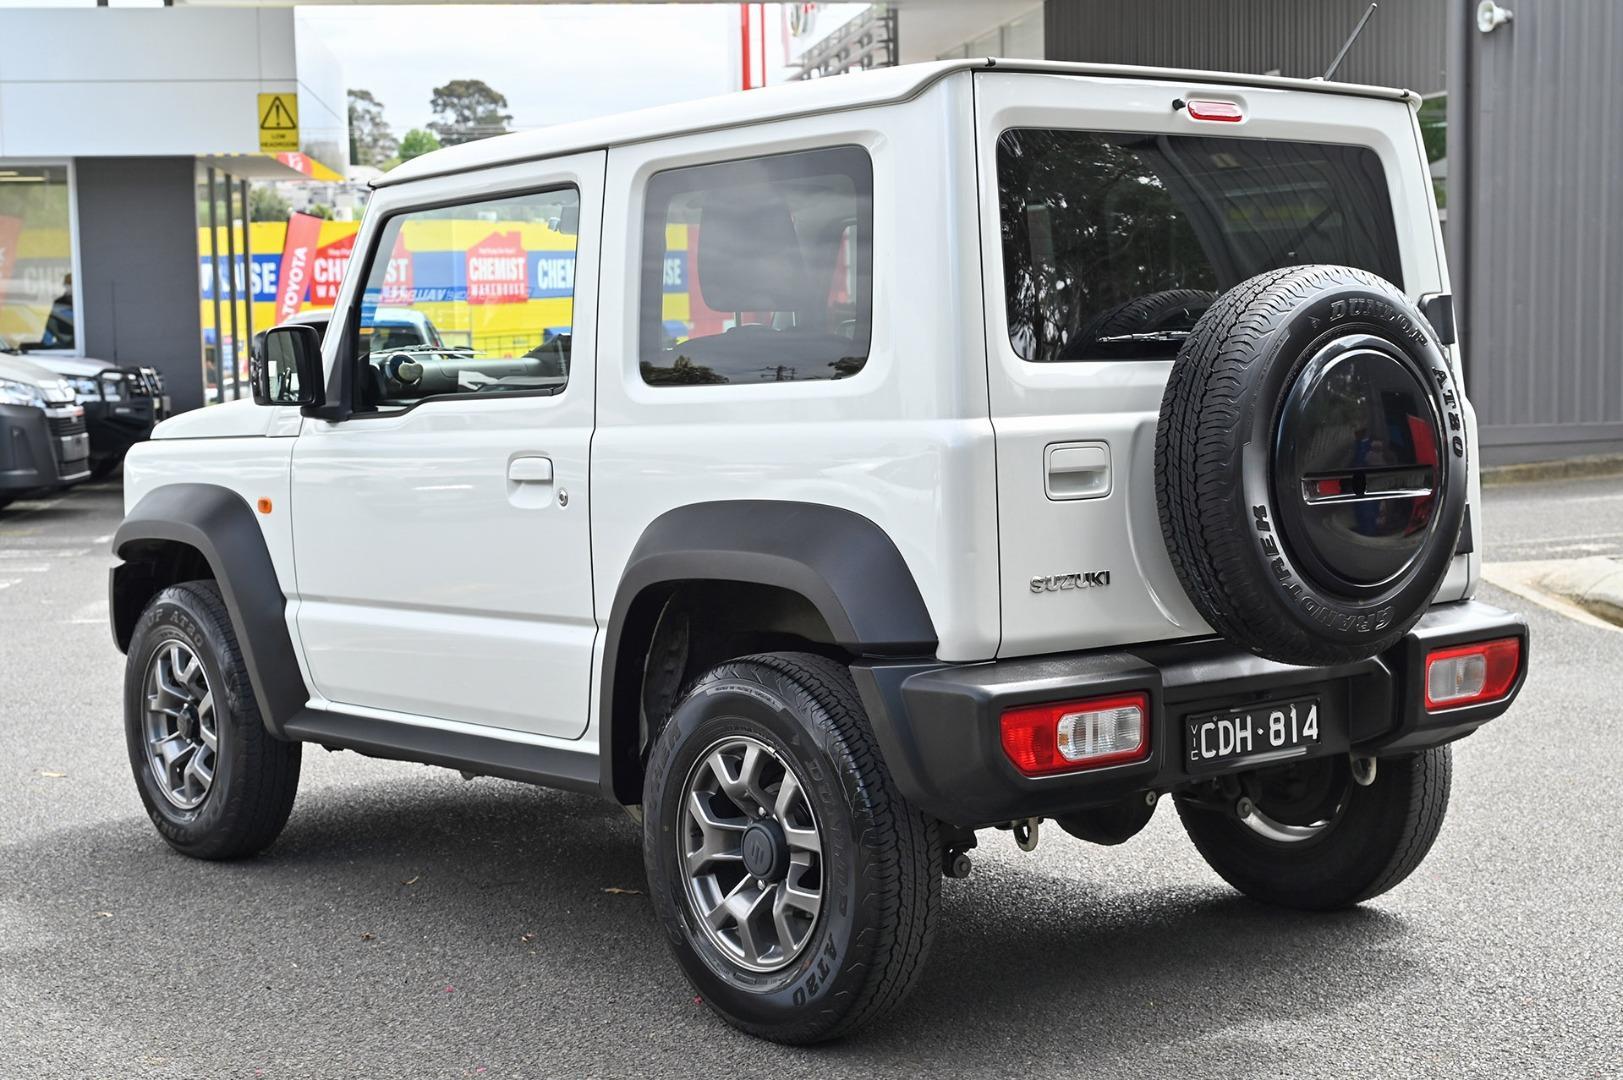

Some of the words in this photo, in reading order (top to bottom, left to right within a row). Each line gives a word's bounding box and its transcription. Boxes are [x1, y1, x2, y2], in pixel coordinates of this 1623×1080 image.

[282, 247, 308, 316] TOYOTA
[469, 256, 525, 281] CHEMIST
[1330, 298, 1428, 346] DUNLOP
[1030, 570, 1110, 593] SUZUKI
[1253, 505, 1393, 632] GRANDTREK
[1191, 724, 1199, 760] VIC
[1201, 715, 1252, 758] CDH
[1269, 705, 1318, 746] 814
[793, 932, 837, 1006] AT20
